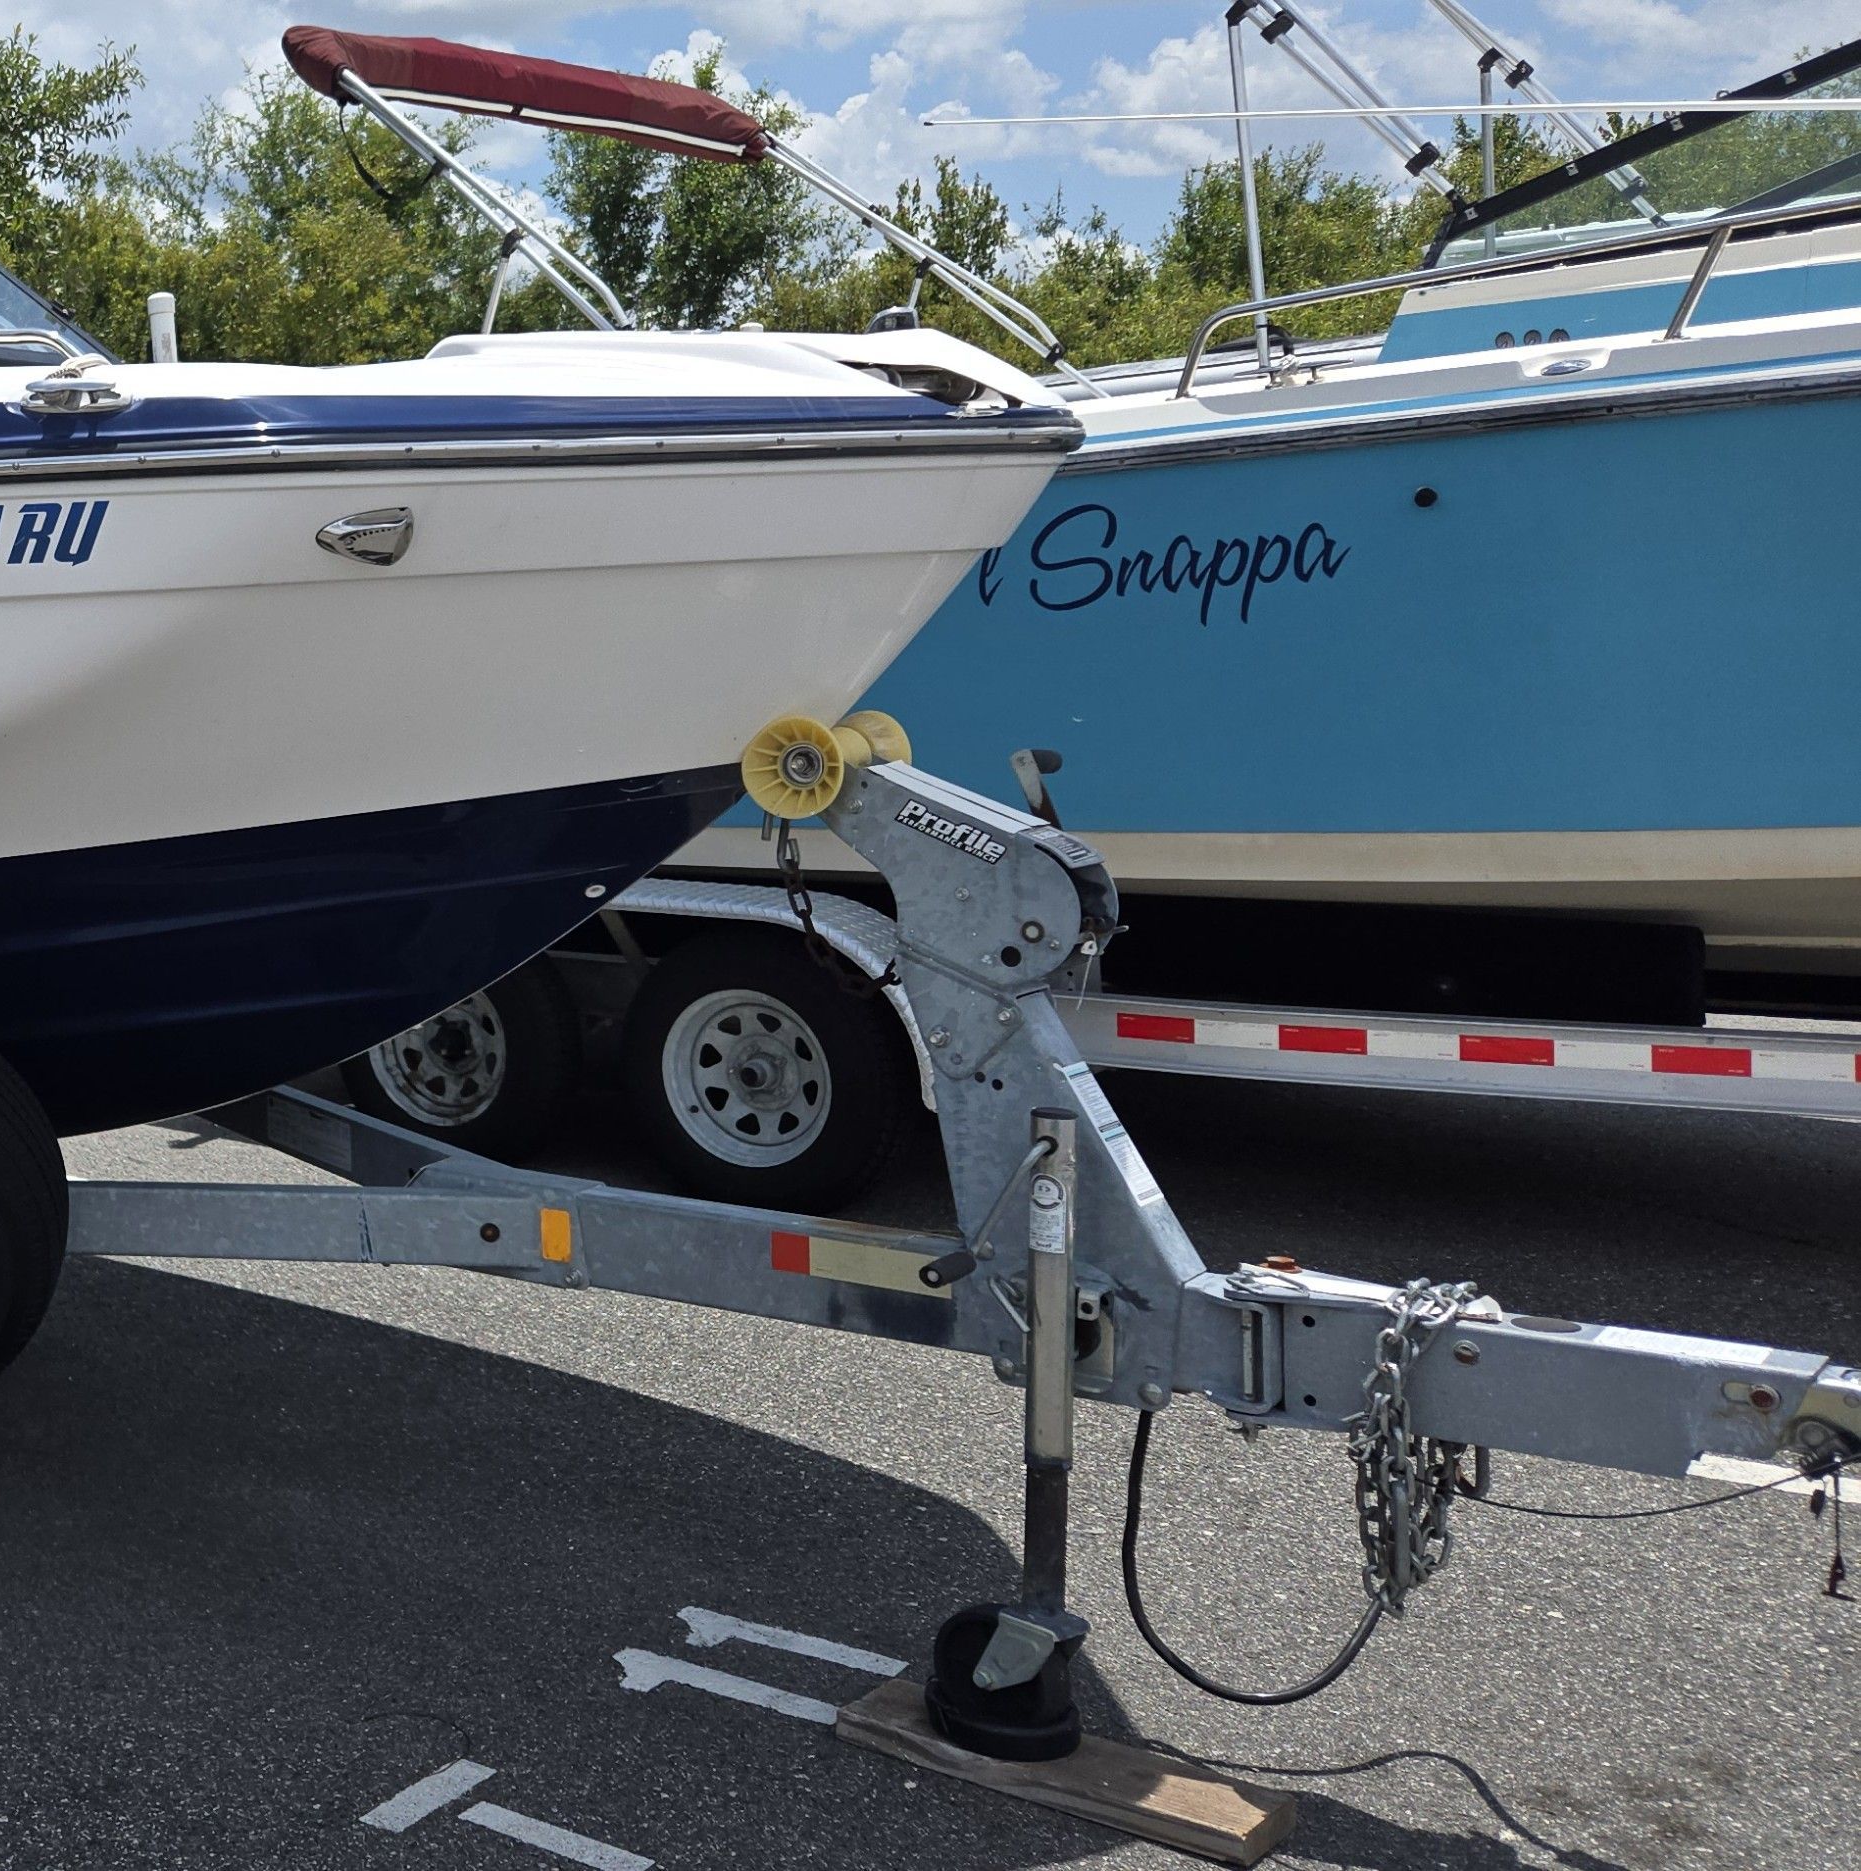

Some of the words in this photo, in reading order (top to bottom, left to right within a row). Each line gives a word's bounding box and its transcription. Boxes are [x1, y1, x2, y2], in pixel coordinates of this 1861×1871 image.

[6, 500, 111, 567] RU
[1029, 503, 1352, 627] Snappa
[896, 815, 964, 849] PERFORMANCE
[964, 845, 998, 864] WINCH
[899, 799, 1006, 859] Profile
